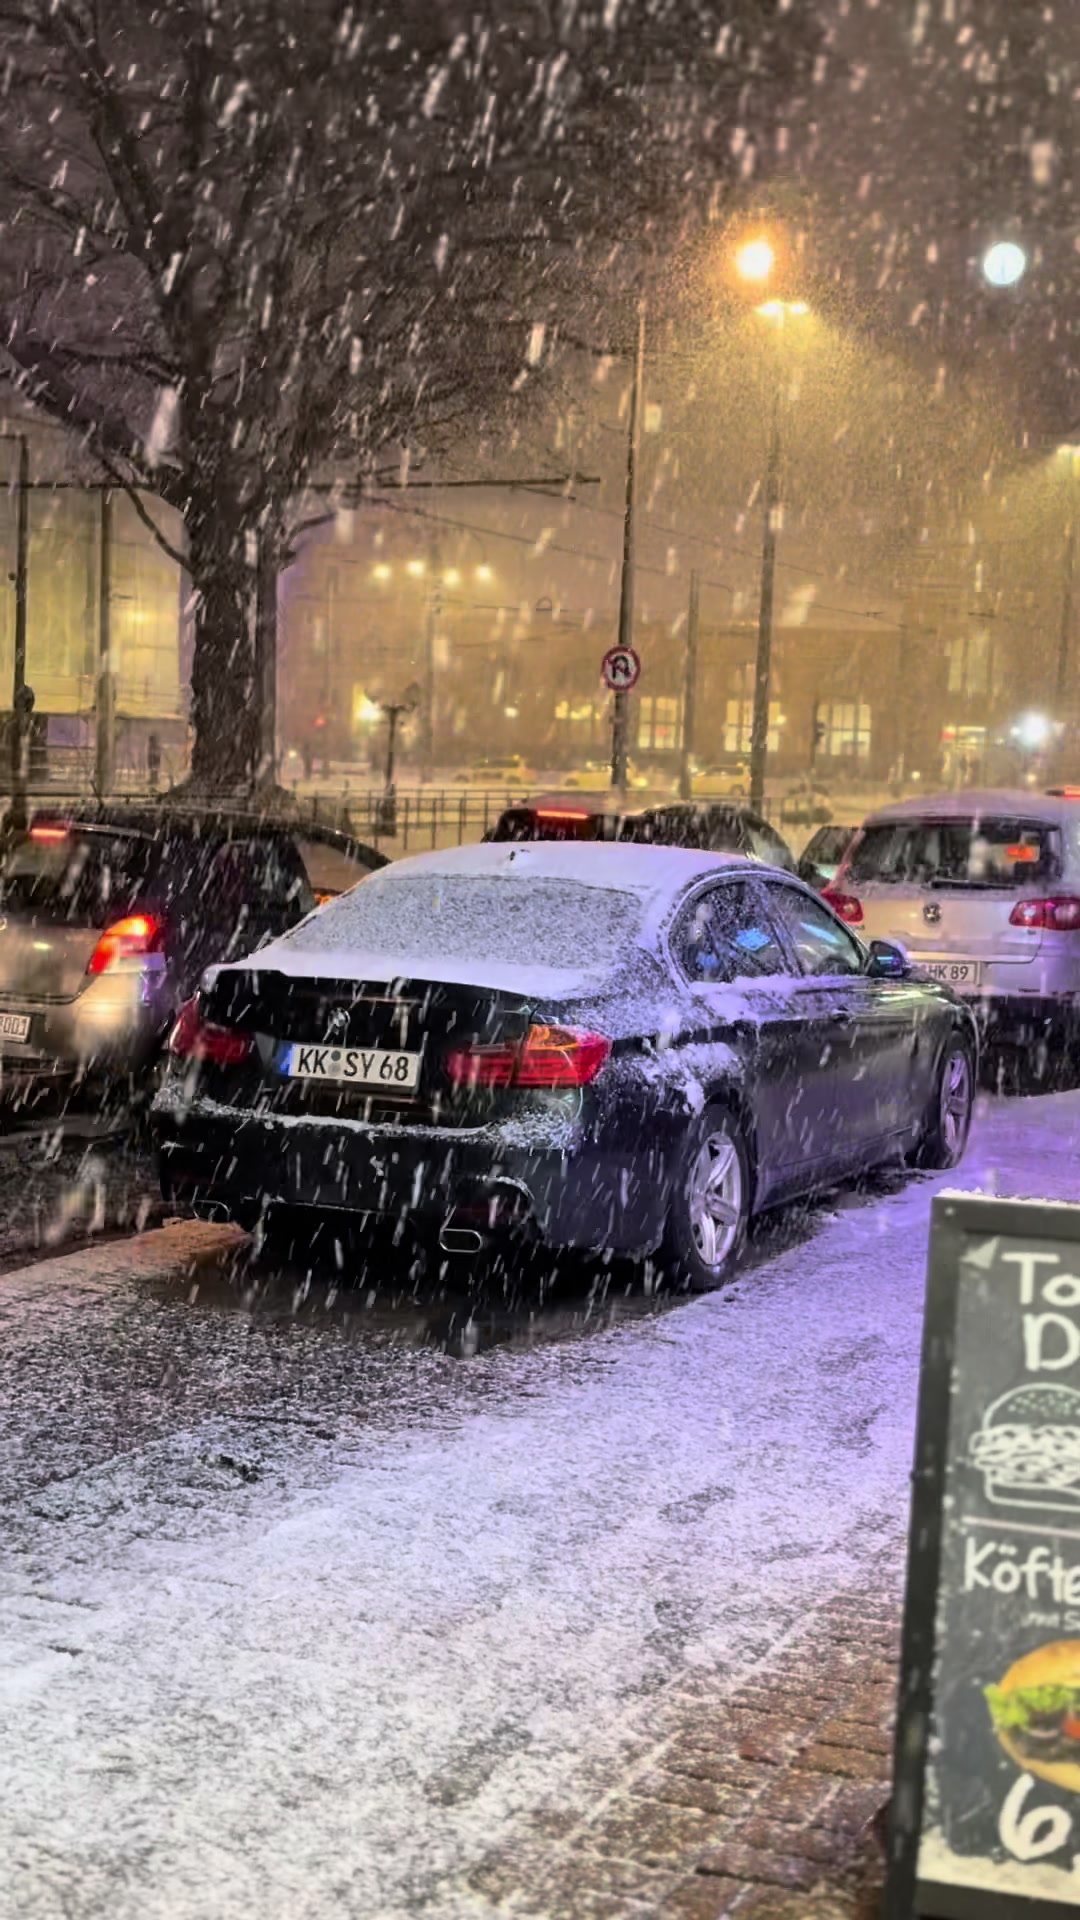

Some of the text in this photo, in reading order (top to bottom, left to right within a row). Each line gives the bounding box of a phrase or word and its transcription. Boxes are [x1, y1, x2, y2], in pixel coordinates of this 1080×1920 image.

[950, 965, 969, 980] 89
[297, 1047, 409, 1081] KK SY 68
